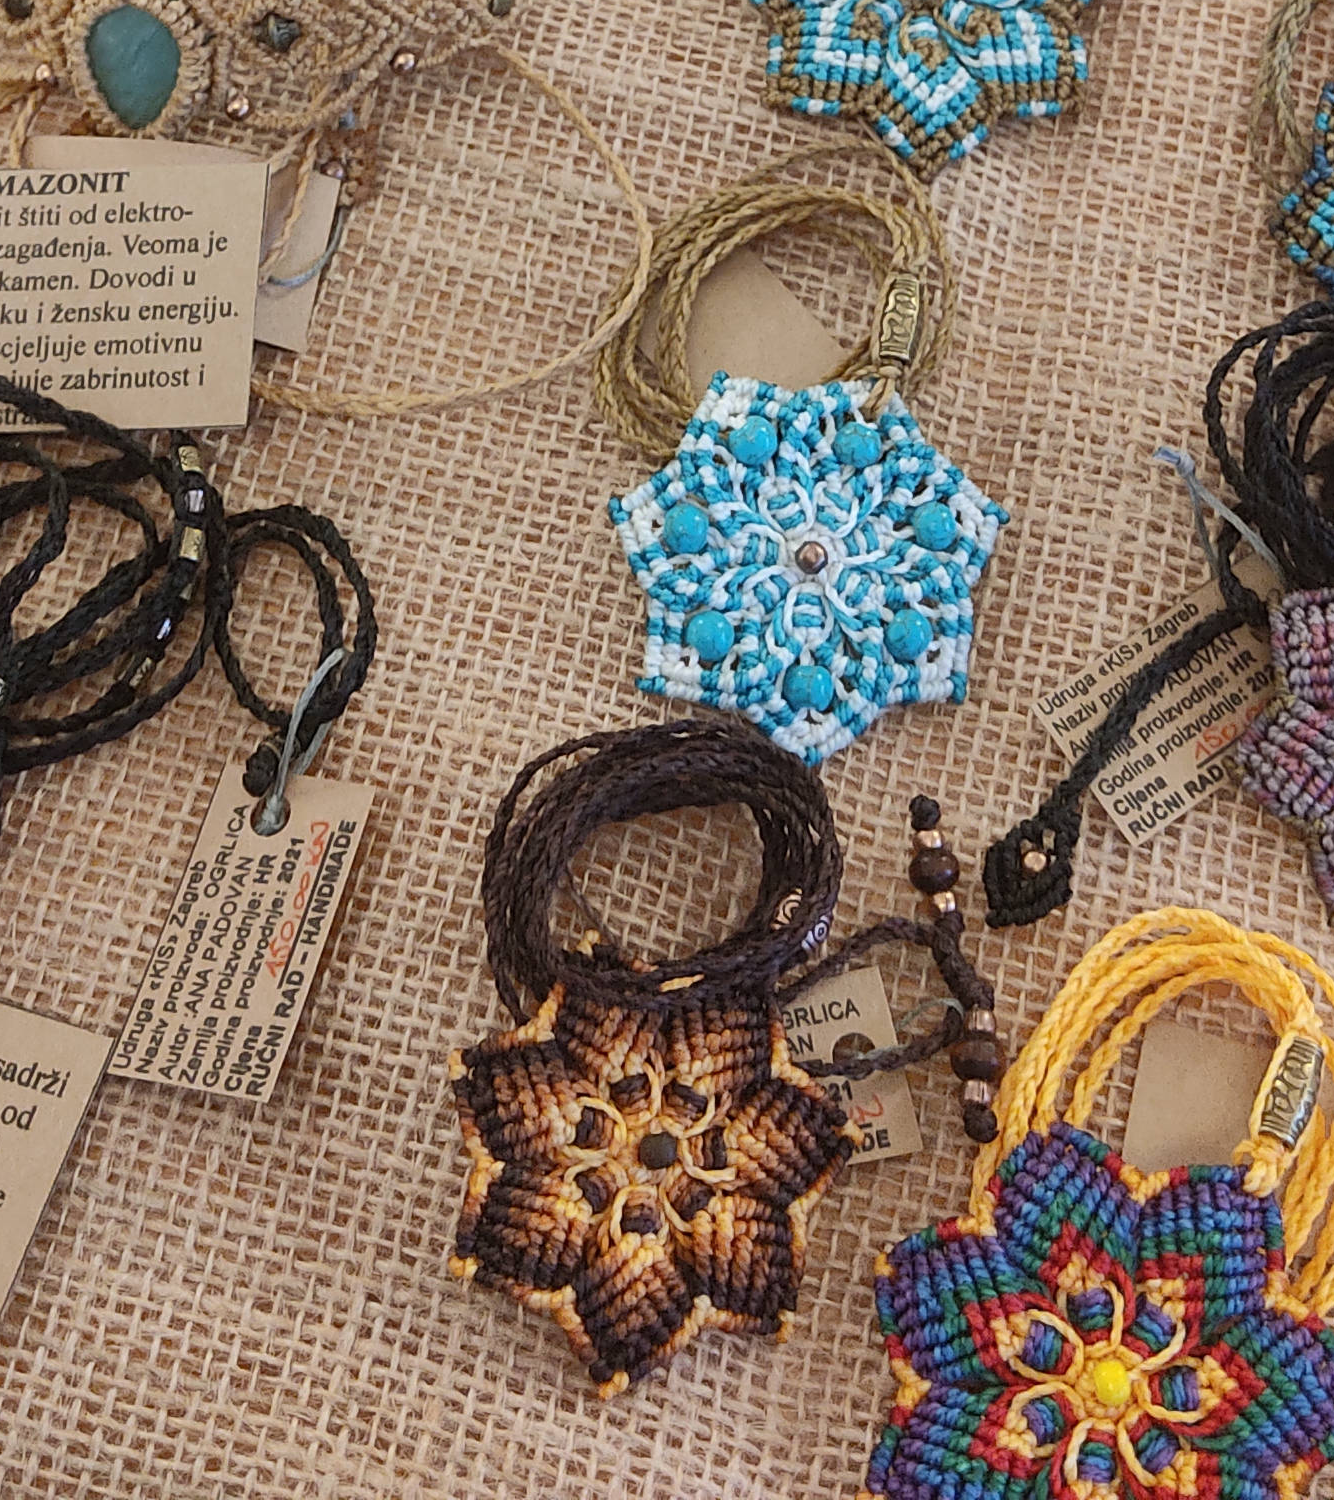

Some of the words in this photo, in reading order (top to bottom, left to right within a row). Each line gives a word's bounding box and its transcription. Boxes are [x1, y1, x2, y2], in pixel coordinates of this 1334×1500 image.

[17, 204, 60, 226] štiti
[68, 203, 97, 225] od
[104, 201, 193, 223] elektro-
[122, 234, 198, 255] Veoma
[202, 230, 227, 258] je
[36, 301, 43, 323] i
[50, 300, 129, 323] žensku
[138, 301, 238, 324] energiju.
[89, 264, 174, 289] Dovodi
[183, 270, 195, 285] u
[1036, 673, 1097, 715] Udruga
[1141, 602, 1199, 646] Zagreb
[1136, 670, 1229, 743] proizvodnje:
[1226, 649, 1257, 675] HR
[1051, 700, 1098, 737] Naziv
[1097, 752, 1156, 795] Godina
[1156, 685, 1249, 761] proizvodnje:
[1112, 775, 1167, 815] Cijena
[1127, 790, 1185, 838] RUČNI
[1183, 763, 1224, 798] RAD
[112, 997, 155, 1068] Udruga
[168, 860, 207, 928] Zagreb
[134, 1017, 168, 1073] Naziv
[162, 911, 210, 1013] proizvoda:
[203, 804, 250, 898] OGRLICA
[157, 1023, 191, 1080] Autor
[201, 856, 254, 961] PADOVAN
[177, 1016, 218, 1084] Zemlja
[209, 891, 264, 1010] proizvodnje:
[252, 854, 277, 884] HR
[202, 1015, 241, 1087] Godina
[234, 890, 287, 1009] proizvodnje:
[276, 837, 304, 883] 2021
[244, 1024, 286, 1096] RUČNI
[273, 970, 304, 1018] RAD
[299, 819, 357, 944] HANDMADE
[781, 998, 861, 1031] GRLICA
[223, 1025, 262, 1091] Cijena
